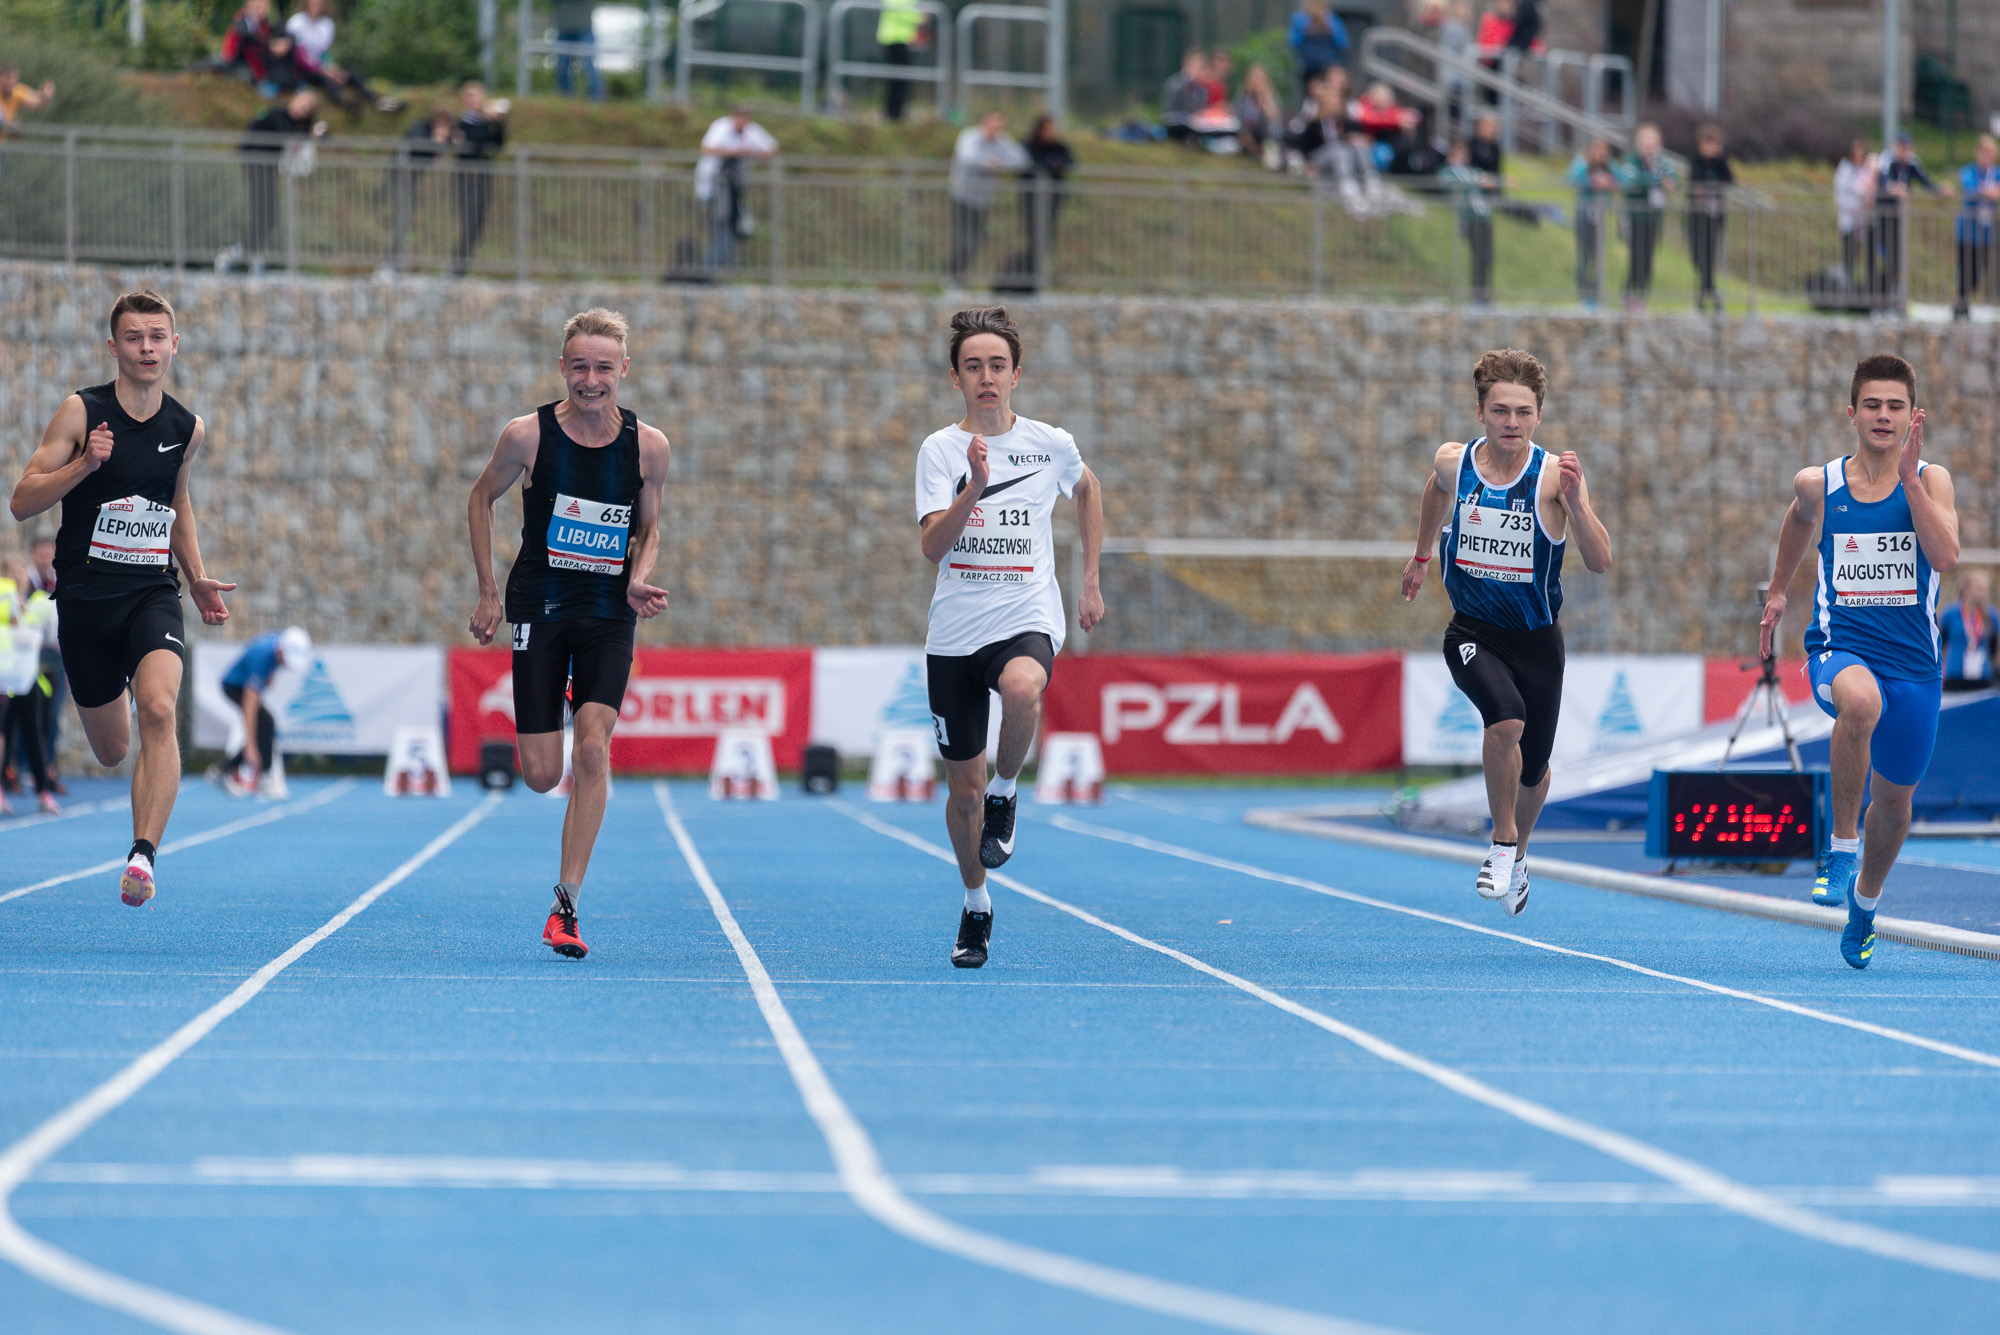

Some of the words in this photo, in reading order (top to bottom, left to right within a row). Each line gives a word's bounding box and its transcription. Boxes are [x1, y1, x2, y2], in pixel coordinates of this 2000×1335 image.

[1008, 454, 1051, 466] VECTRA
[109, 504, 133, 512] ORLEN
[600, 507, 631, 525] 655
[998, 509, 1030, 526] 131
[1500, 513, 1532, 532] 733
[97, 517, 168, 538] LEPIONKA
[556, 525, 620, 551] LIBURA
[1459, 533, 1532, 558] PIETRZYK
[1876, 535, 1912, 552] 516
[100, 550, 140, 563] KARPACZ
[141, 555, 159, 563] 2021
[551, 558, 592, 572] KARPACZ
[593, 565, 611, 573] 2021
[1464, 567, 1500, 580] KARPACZ
[1501, 573, 1521, 581] 2021
[1836, 563, 1914, 581] AUGUSTYN
[960, 571, 1001, 581] KARPACZ
[1003, 573, 1023, 581] 2021
[1844, 597, 1884, 606] KARPACZ
[1886, 597, 1906, 605] 2021
[514, 622, 524, 647] 4
[1462, 645, 1475, 661] 2
[616, 690, 767, 724] ORLEN
[1102, 682, 1343, 744] PZLA
